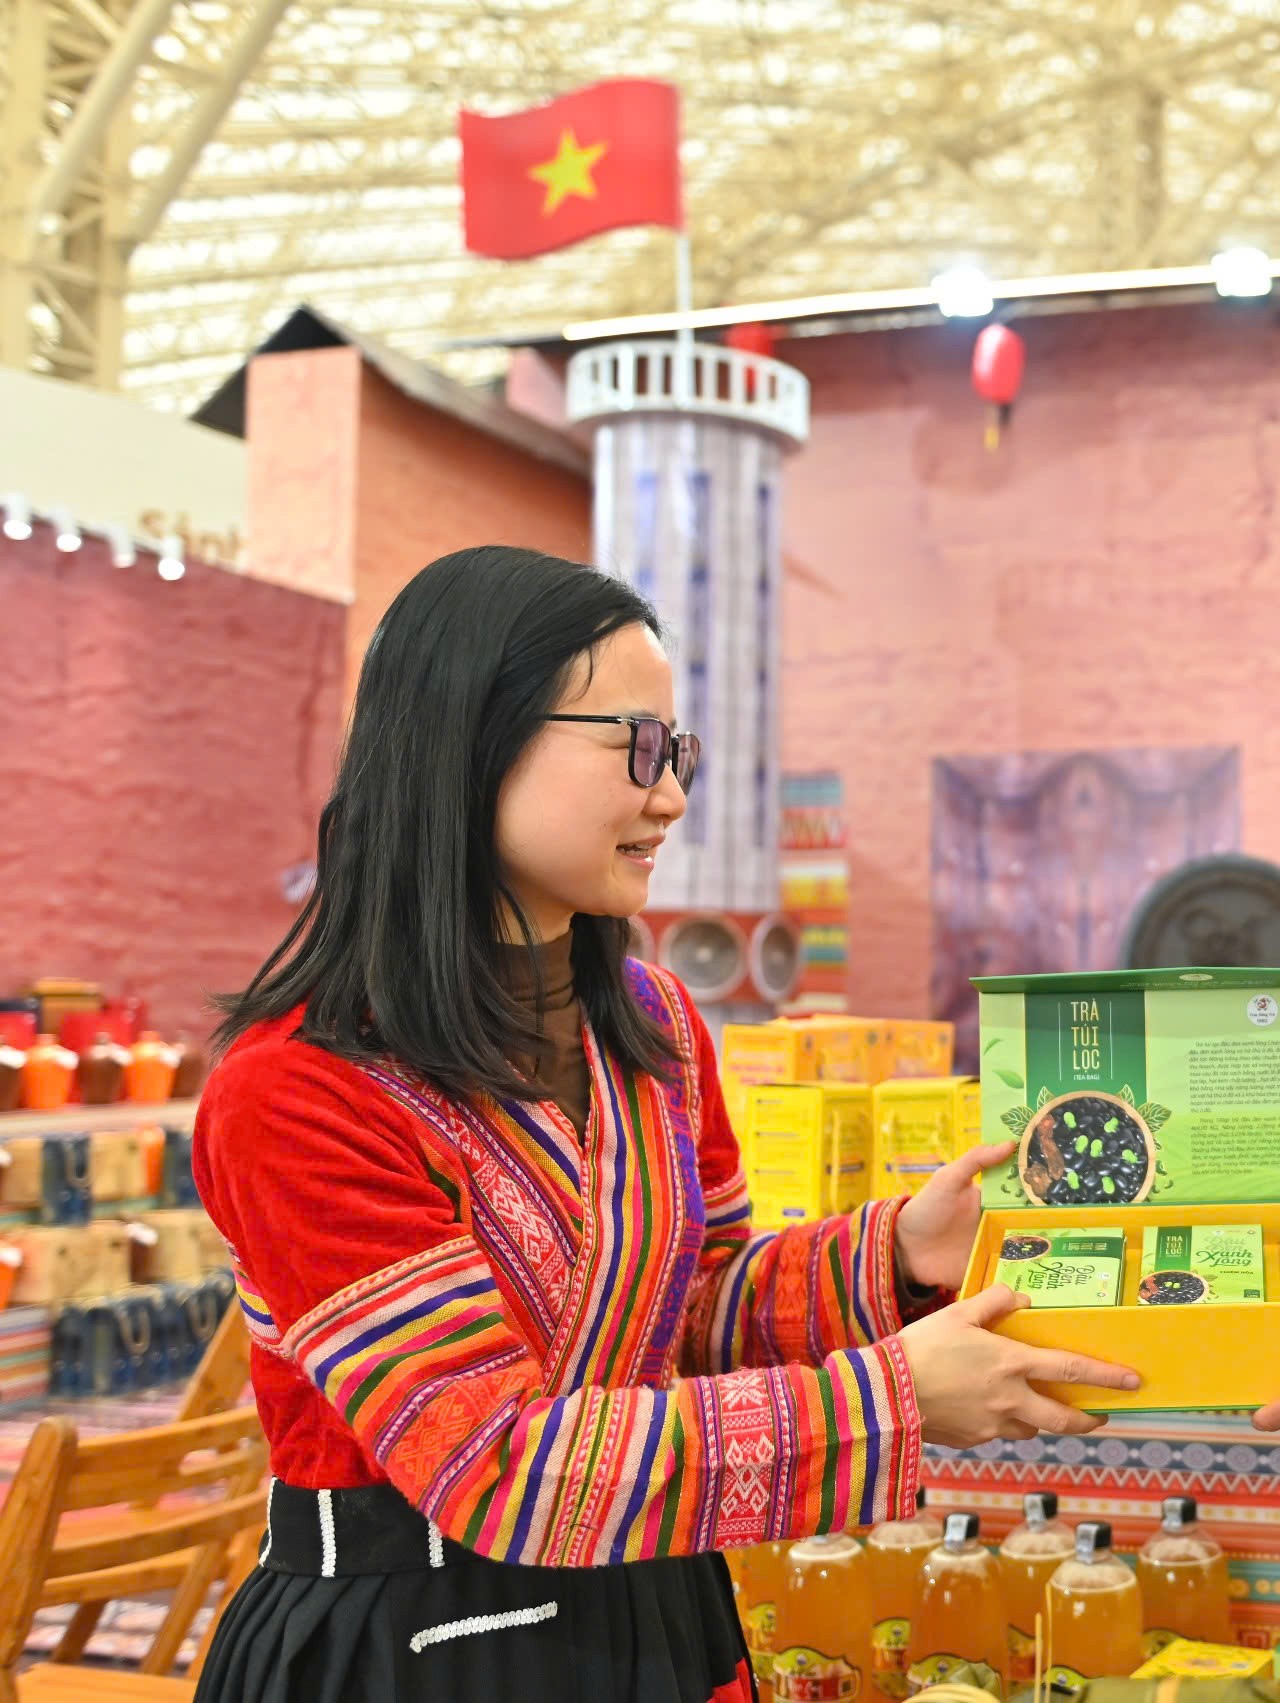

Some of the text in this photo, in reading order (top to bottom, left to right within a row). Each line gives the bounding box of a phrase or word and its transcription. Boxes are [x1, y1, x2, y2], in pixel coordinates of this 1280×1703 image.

[1070, 998, 1099, 1022] TRÀ
[1071, 1023, 1099, 1047] TÚI
[1073, 1049, 1100, 1073] LỌC
